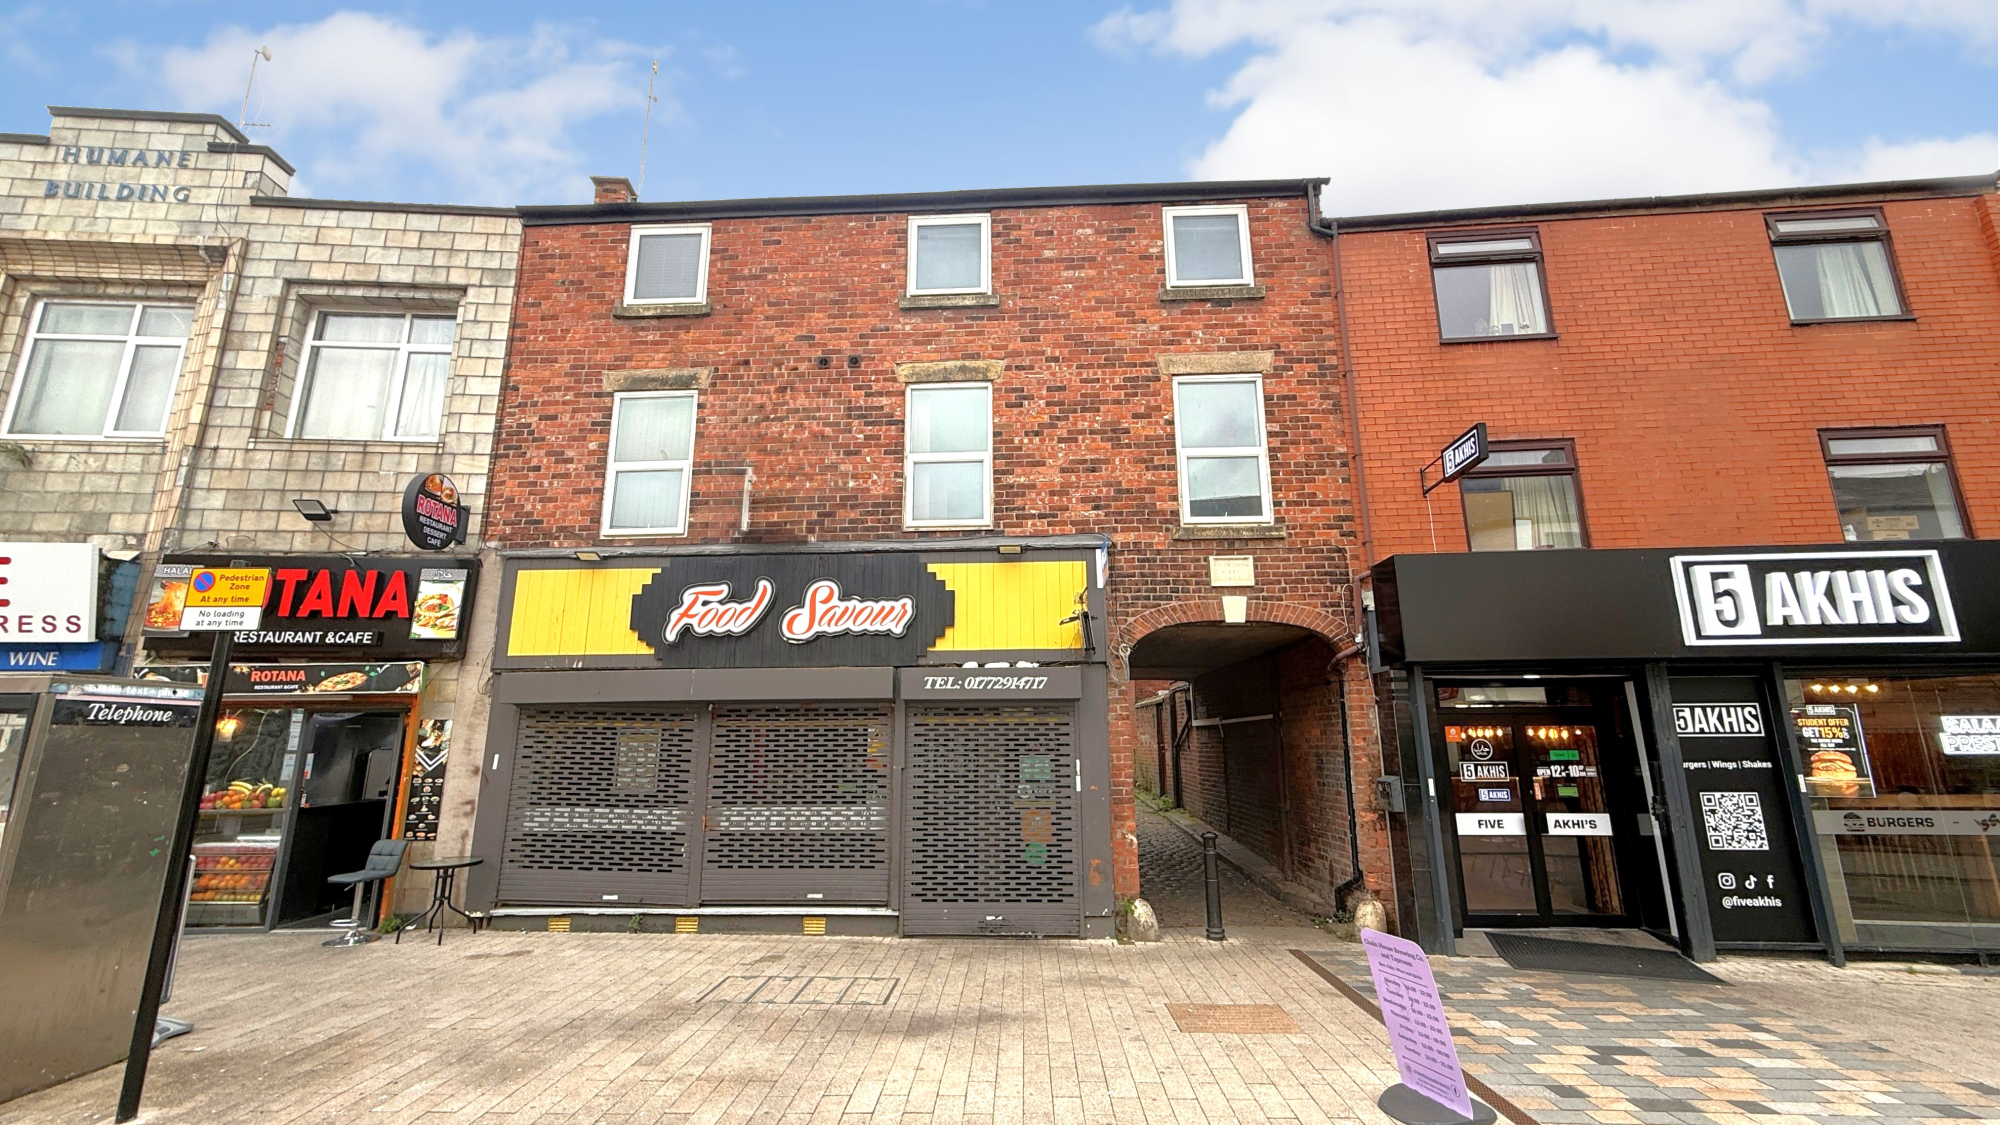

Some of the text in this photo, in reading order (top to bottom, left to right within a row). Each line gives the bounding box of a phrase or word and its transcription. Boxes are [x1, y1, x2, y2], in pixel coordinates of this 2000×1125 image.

[62, 146, 191, 168] HUMANE
[44, 179, 191, 202] BUILDING
[1455, 438, 1476, 466] AKHIS
[417, 494, 457, 527] ROTANA
[419, 515, 453, 533] RESTAURANT
[423, 526, 447, 540] DESSERT
[219, 574, 265, 582] Pedestrian
[200, 595, 211, 603] At
[231, 595, 250, 603] time
[263, 568, 410, 618] TANA
[1765, 568, 1930, 626] AKHIS
[213, 610, 245, 619] loading
[667, 582, 911, 638] Food Savour
[234, 631, 323, 643] RESTAURANT
[9, 651, 60, 666] WINE
[250, 670, 306, 682] ROTANA
[924, 676, 1048, 689] TEL: 01772914717
[157, 687, 190, 698] phne
[87, 703, 173, 724] Telephone
[1694, 707, 1760, 733] AKHIS
[1797, 718, 1849, 726] STUDENT OFFER
[1946, 717, 2000, 732] SALA
[1464, 764, 1506, 779] 5 AKHIS
[1683, 760, 1772, 770] rgers Wings Shakes
[1489, 790, 1509, 799] AKHIS
[1477, 819, 1598, 829] FIVE AKHI'S
[1866, 817, 1935, 828] BURGERS
[1722, 896, 1782, 909] @fiveakhis
